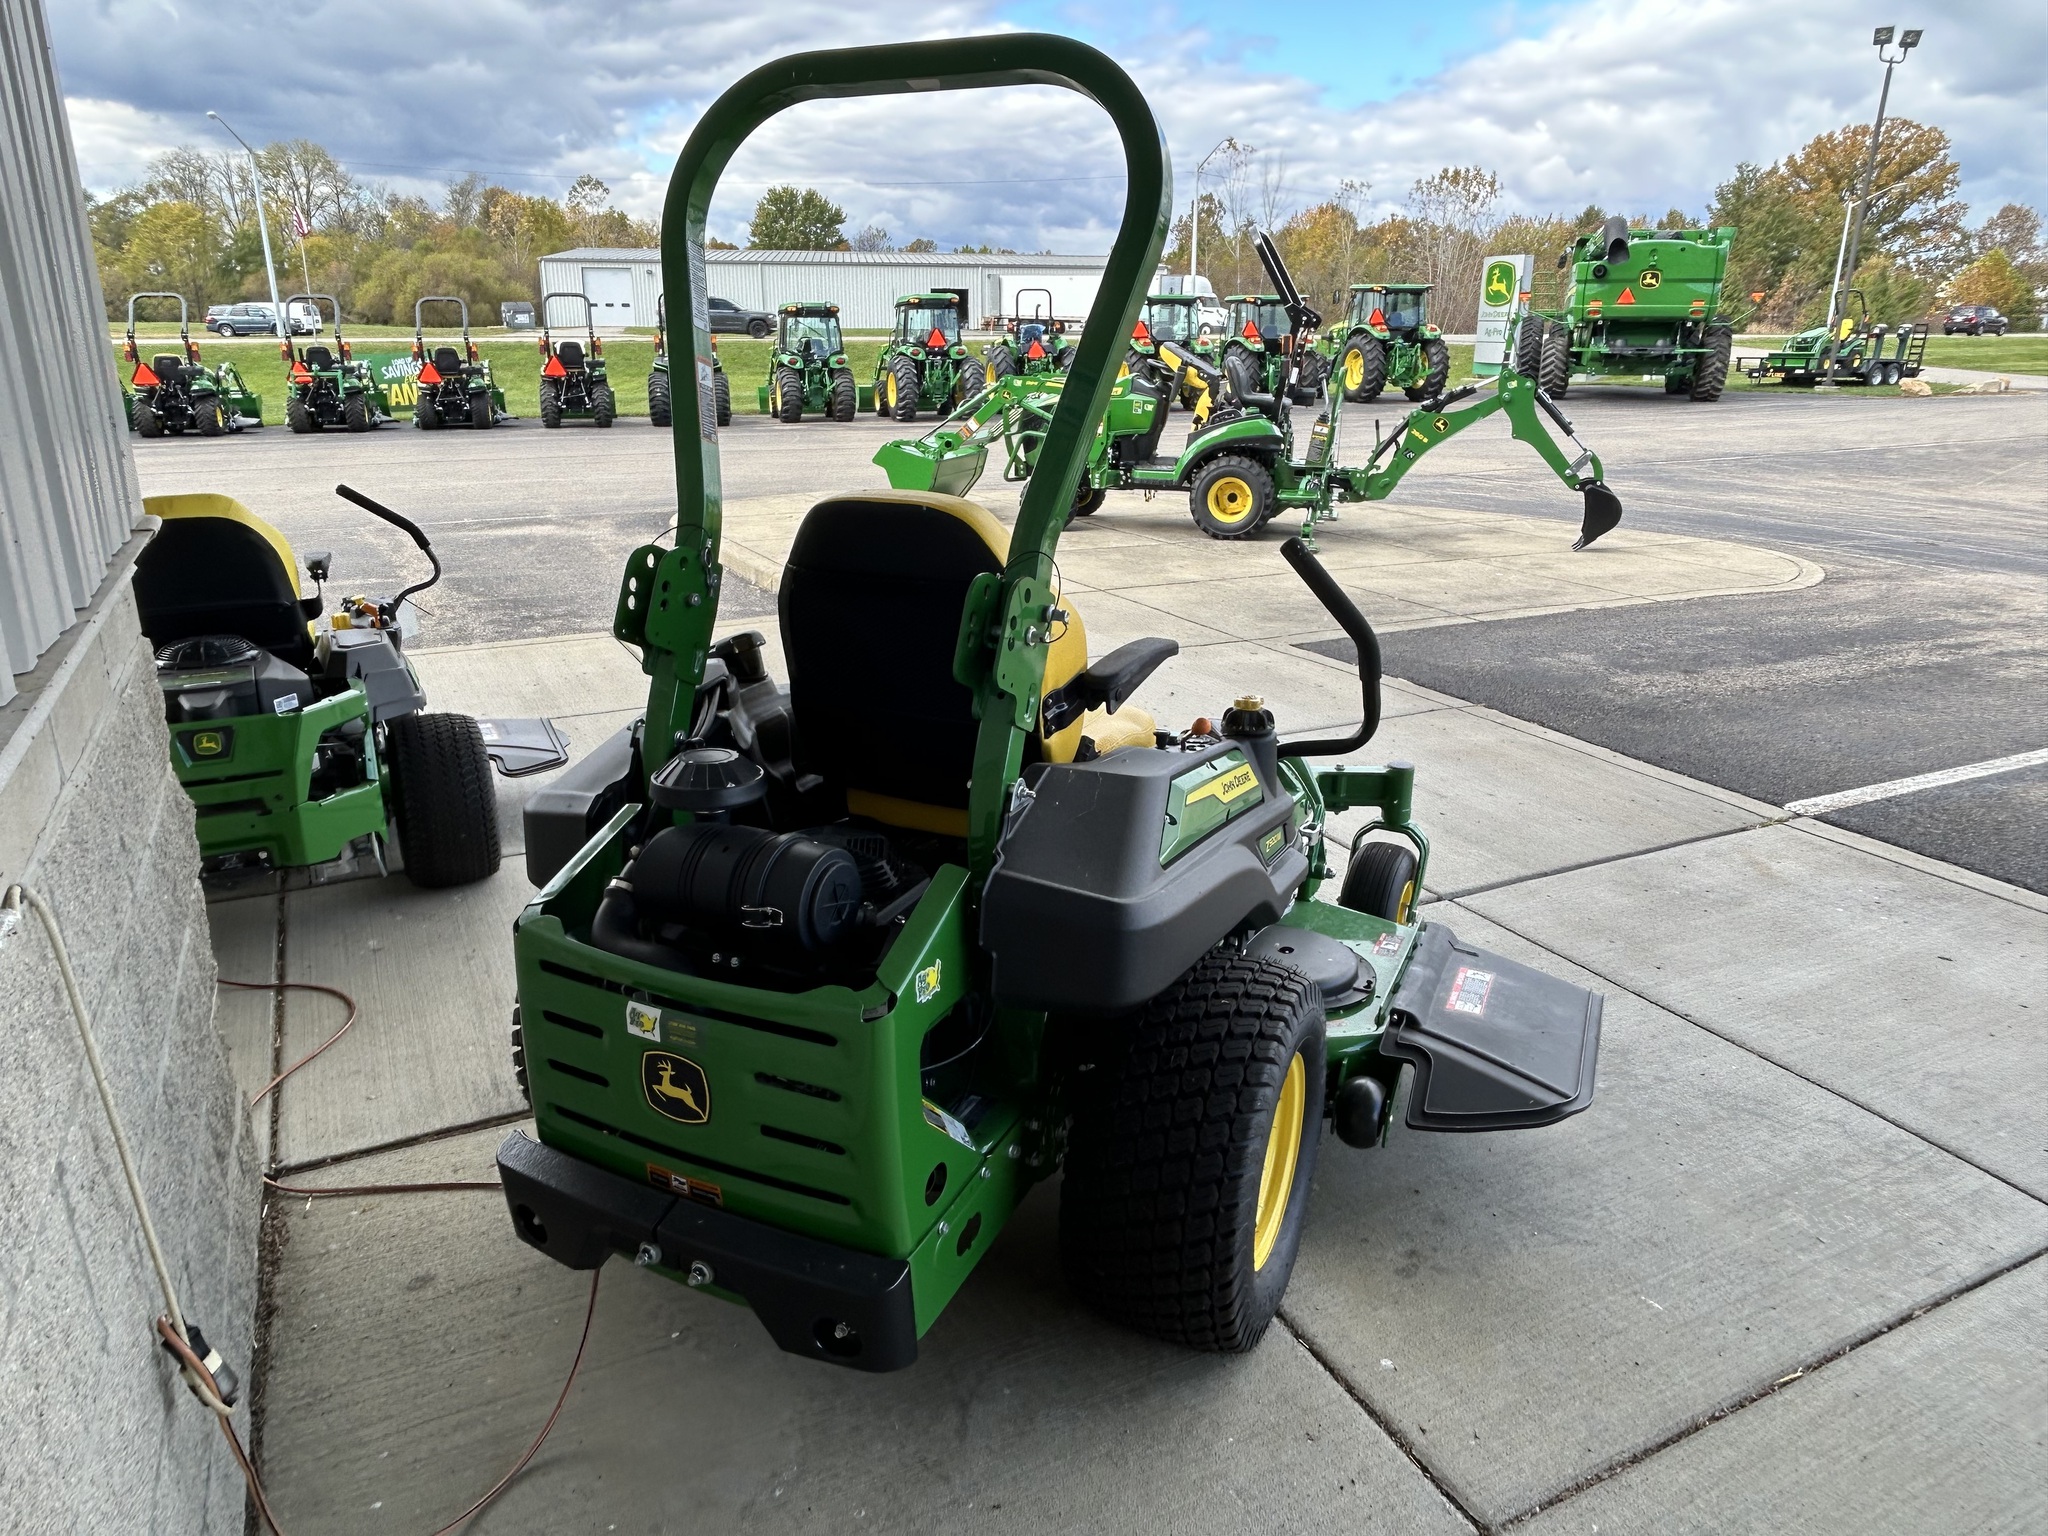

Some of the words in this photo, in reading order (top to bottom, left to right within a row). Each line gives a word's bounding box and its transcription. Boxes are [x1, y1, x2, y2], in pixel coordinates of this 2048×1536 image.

[381, 359, 423, 379] SAVINGS
[1221, 780, 1236, 795] JOHN
[1234, 771, 1251, 787] DEERE
